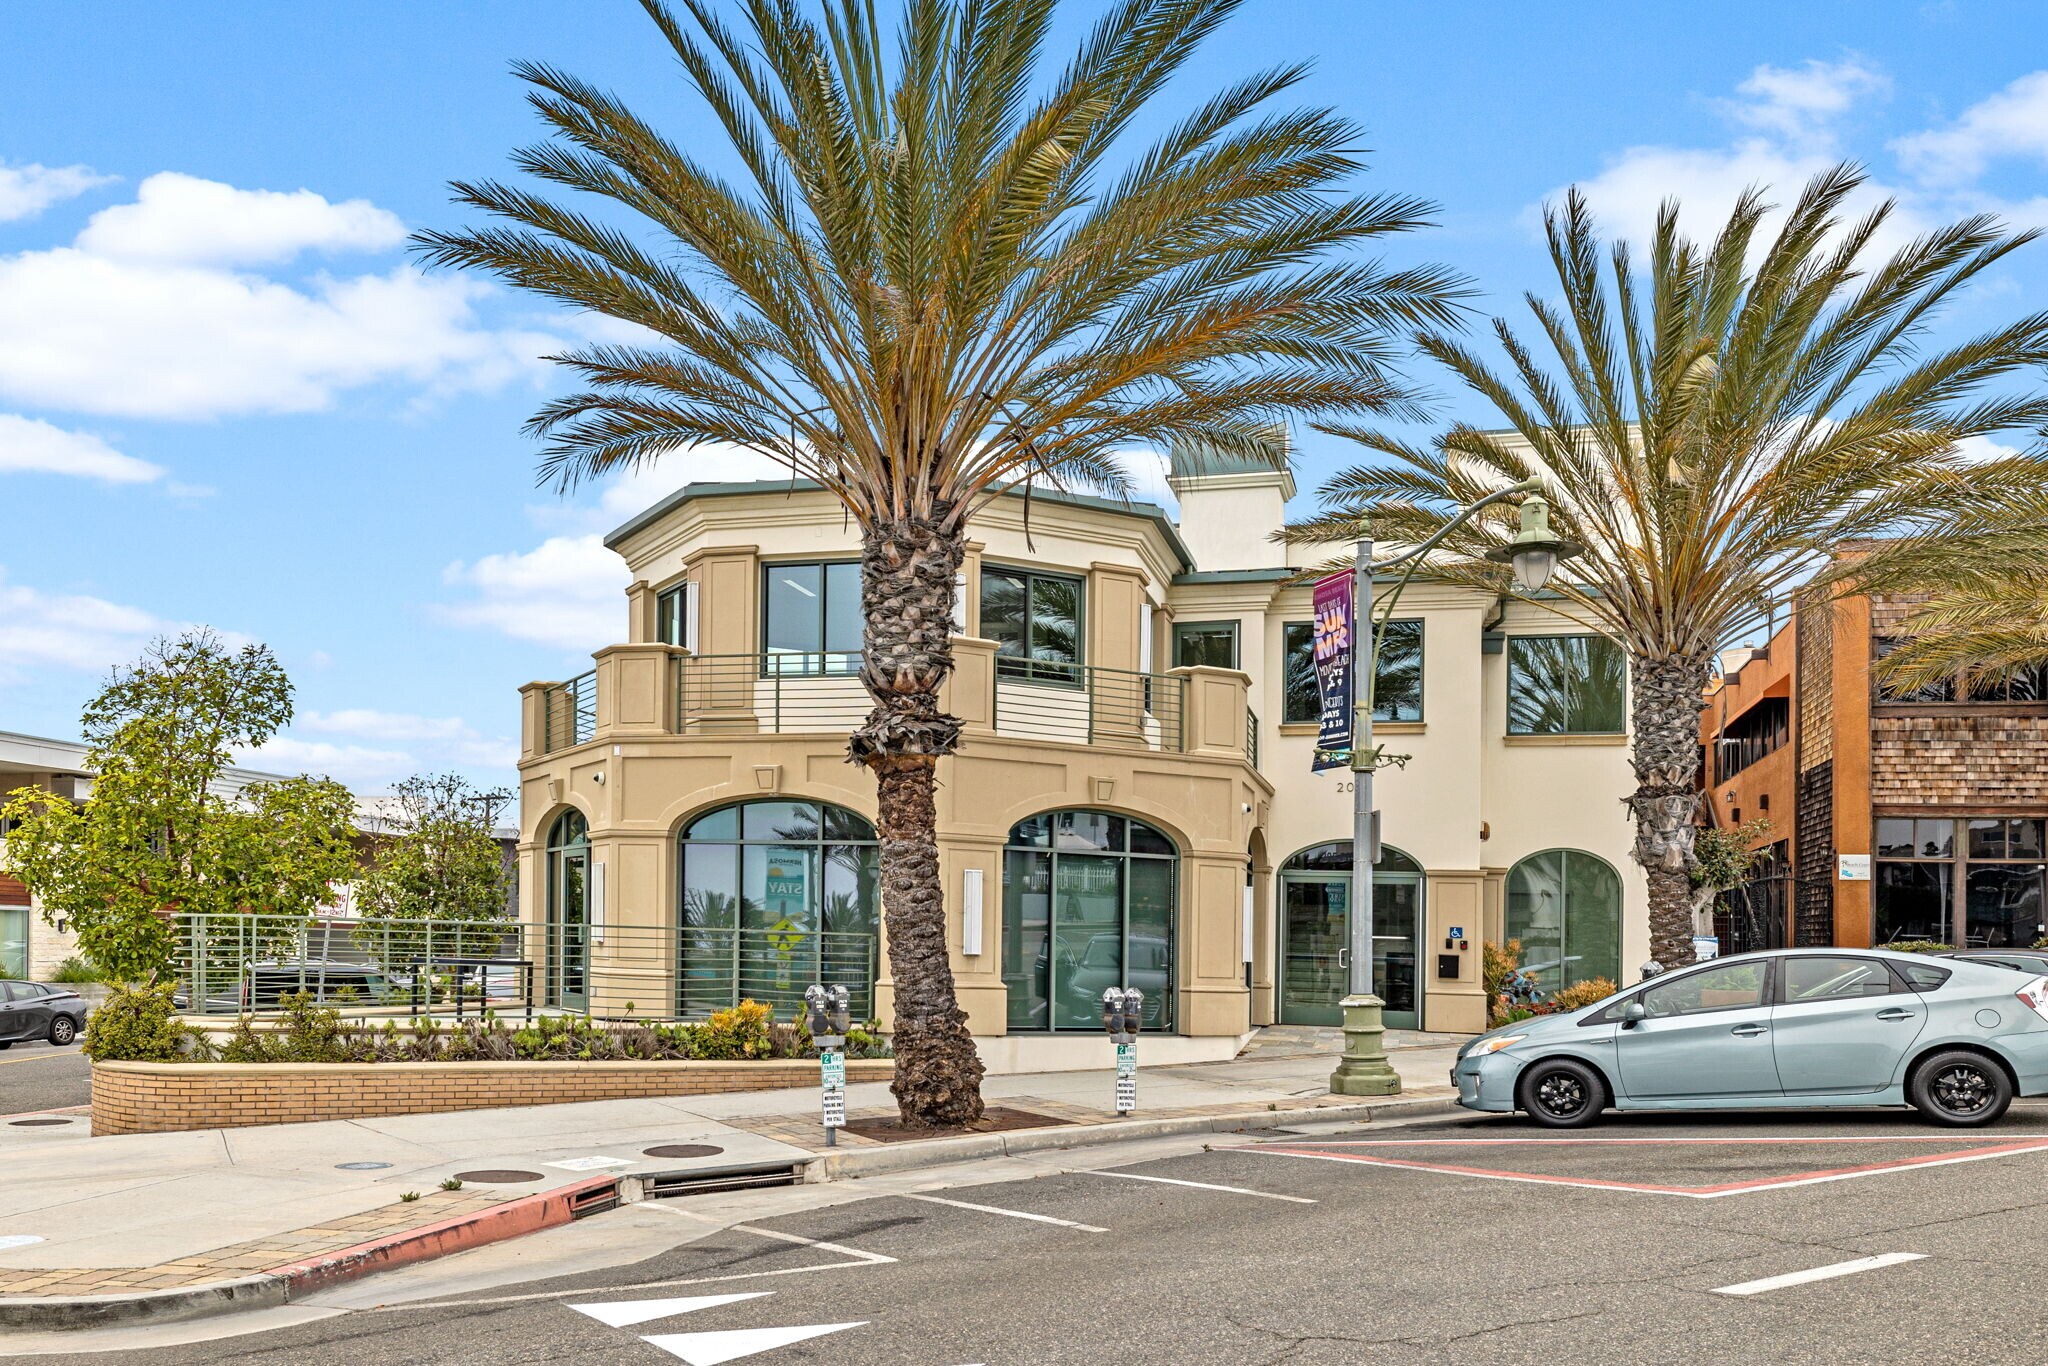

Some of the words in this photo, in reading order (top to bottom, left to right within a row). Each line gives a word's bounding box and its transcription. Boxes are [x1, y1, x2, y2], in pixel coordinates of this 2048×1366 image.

[1335, 718, 1344, 728] 10
[1119, 1046, 1124, 1054] 2
[824, 1054, 829, 1064] 2
